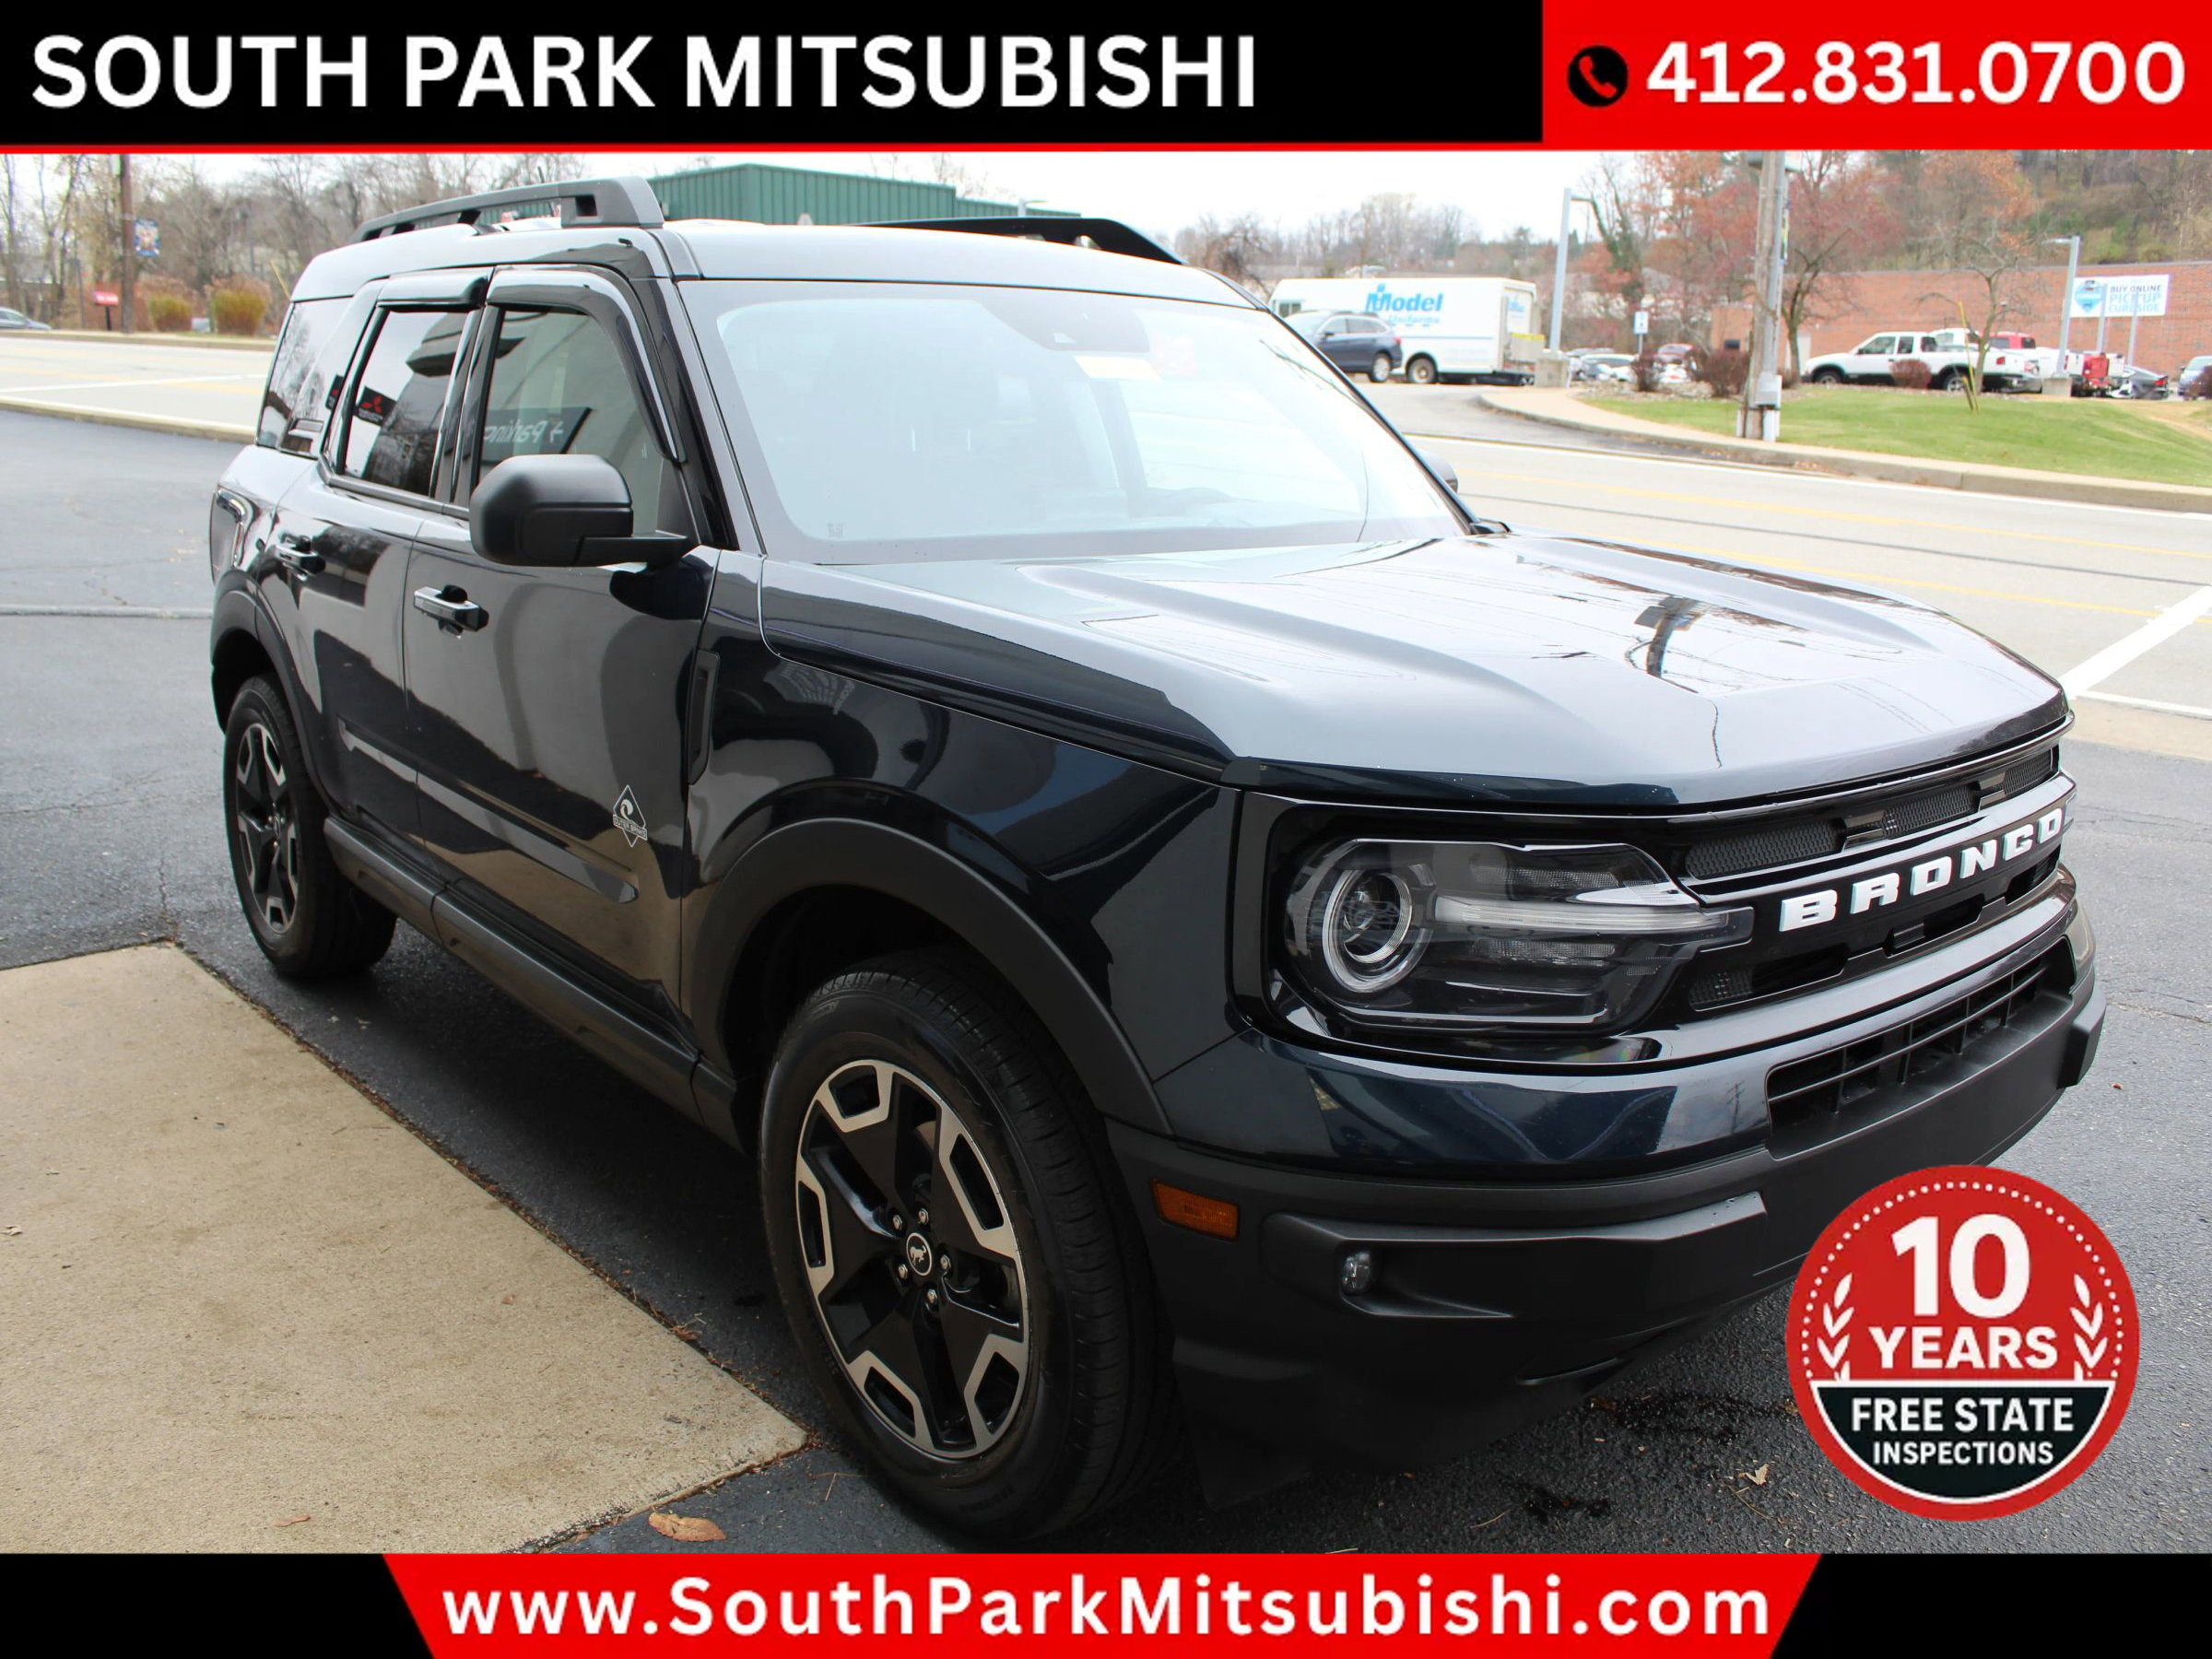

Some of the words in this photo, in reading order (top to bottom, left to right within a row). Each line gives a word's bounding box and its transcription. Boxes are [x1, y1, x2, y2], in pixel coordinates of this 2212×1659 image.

[2130, 284, 2161, 292] ONLINE
[1365, 287, 1443, 313] Model
[2109, 303, 2159, 312] CURSIDE
[1779, 807, 2064, 933] BRONCO
